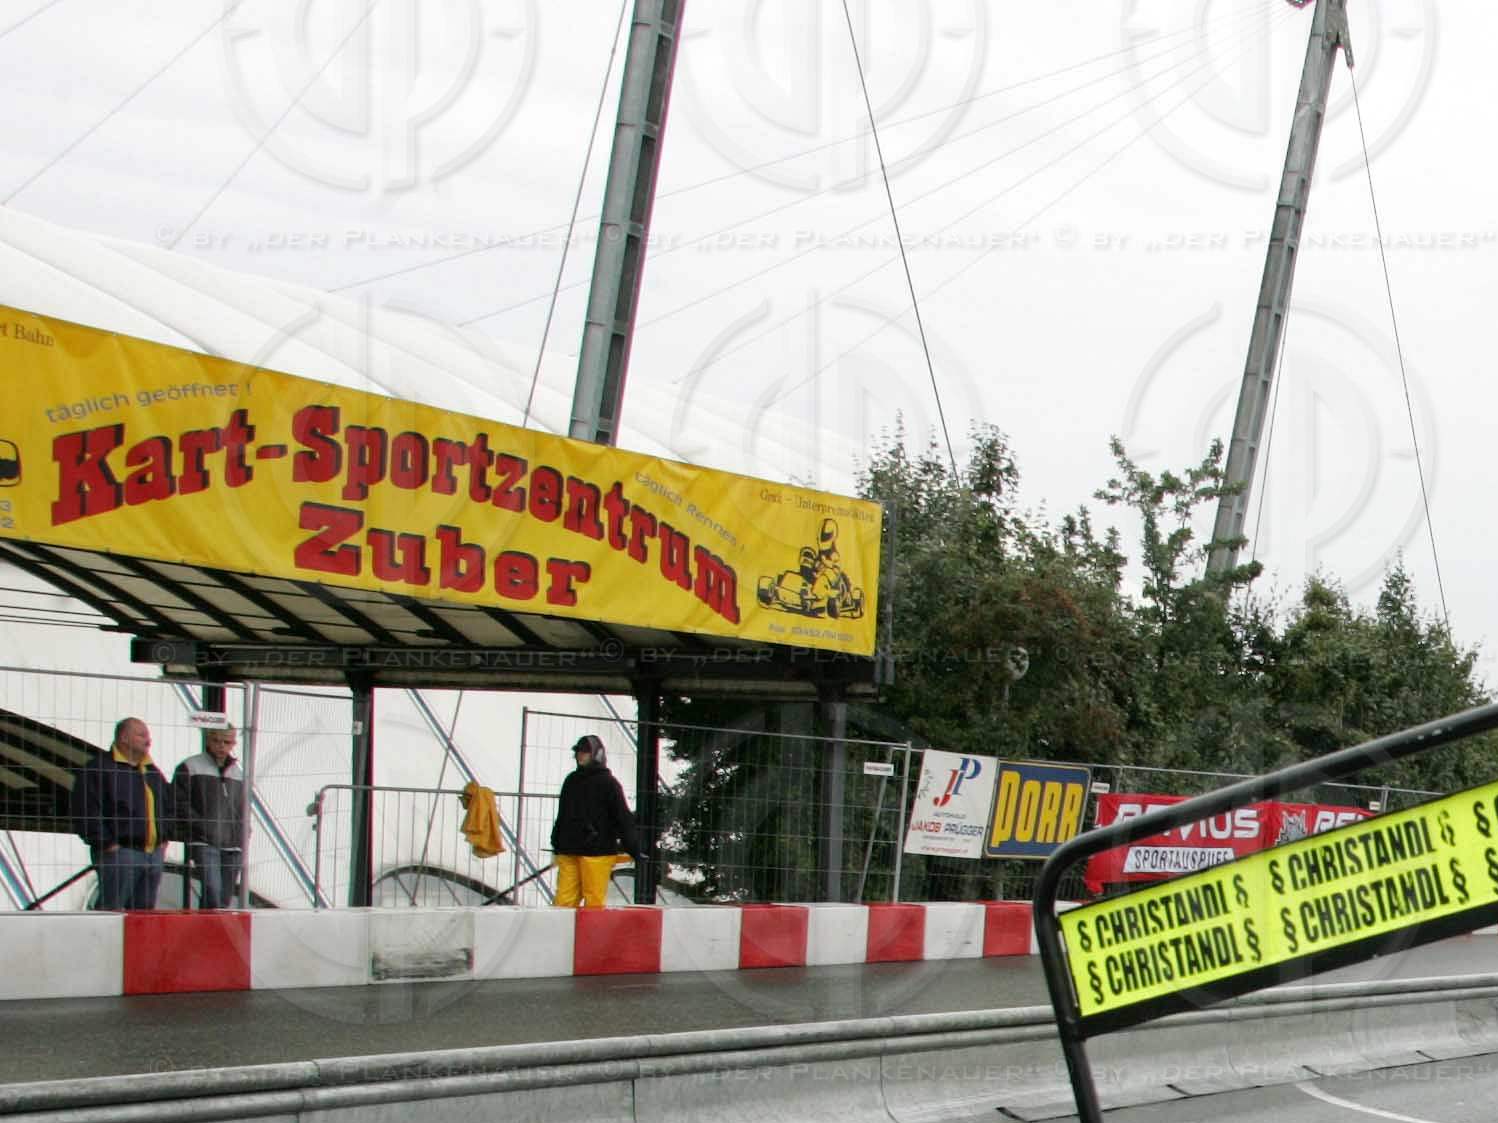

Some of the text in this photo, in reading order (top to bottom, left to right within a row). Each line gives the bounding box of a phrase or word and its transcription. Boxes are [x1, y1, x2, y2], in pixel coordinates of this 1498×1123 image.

[14, 323, 54, 347] Bahn
[44, 389, 130, 423] täglich
[136, 382, 238, 407] geöffnet
[51, 406, 741, 625] Kart-Sportzentrum
[294, 500, 592, 608] Zuber
[1288, 816, 1437, 891] CHRISTANDL
[1096, 880, 1231, 947] CHRISTANDL
[1301, 864, 1450, 943] CHRISTANDL
[1106, 922, 1244, 997] CHRISTANDL
